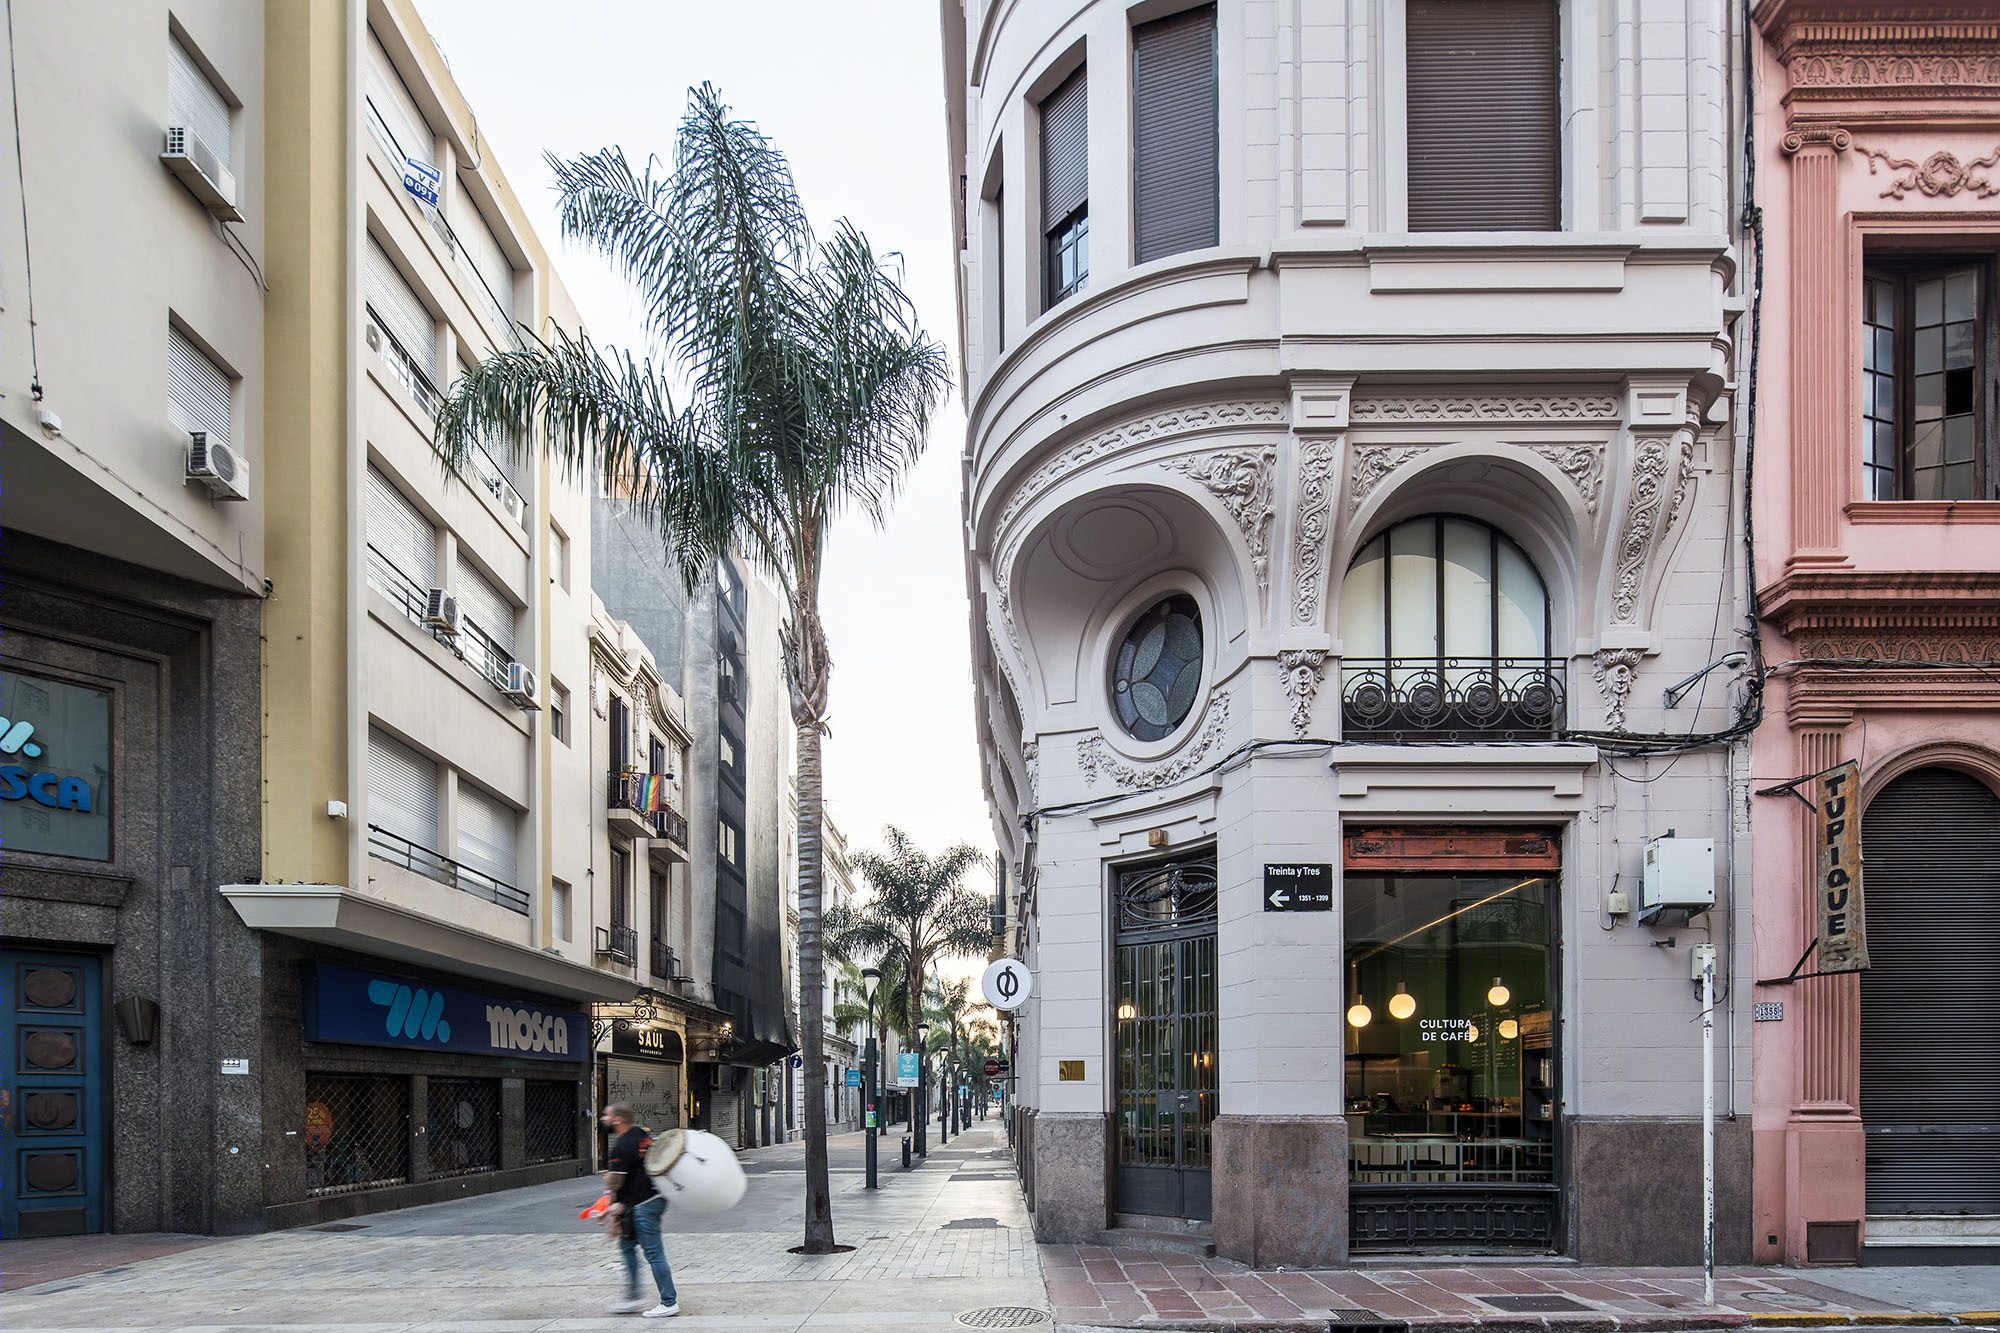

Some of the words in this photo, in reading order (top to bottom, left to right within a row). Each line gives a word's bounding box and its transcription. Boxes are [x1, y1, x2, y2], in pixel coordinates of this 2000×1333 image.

[414, 182, 433, 200] 091
[1825, 774, 1850, 936] TUPIQUE
[1268, 866, 1295, 876] Treinta
[1296, 868, 1302, 878] y
[1303, 866, 1320, 876] Tres
[1298, 894, 1311, 902] 1351
[1316, 894, 1329, 902] 1399
[1759, 1007, 1778, 1017] 1355
[486, 1004, 568, 1055] MOSCA
[1419, 1019, 1473, 1029] CULTURA
[638, 1028, 664, 1049] SAÚL
[1422, 1032, 1437, 1041] DE
[1440, 1030, 1470, 1041] CAFÉ
